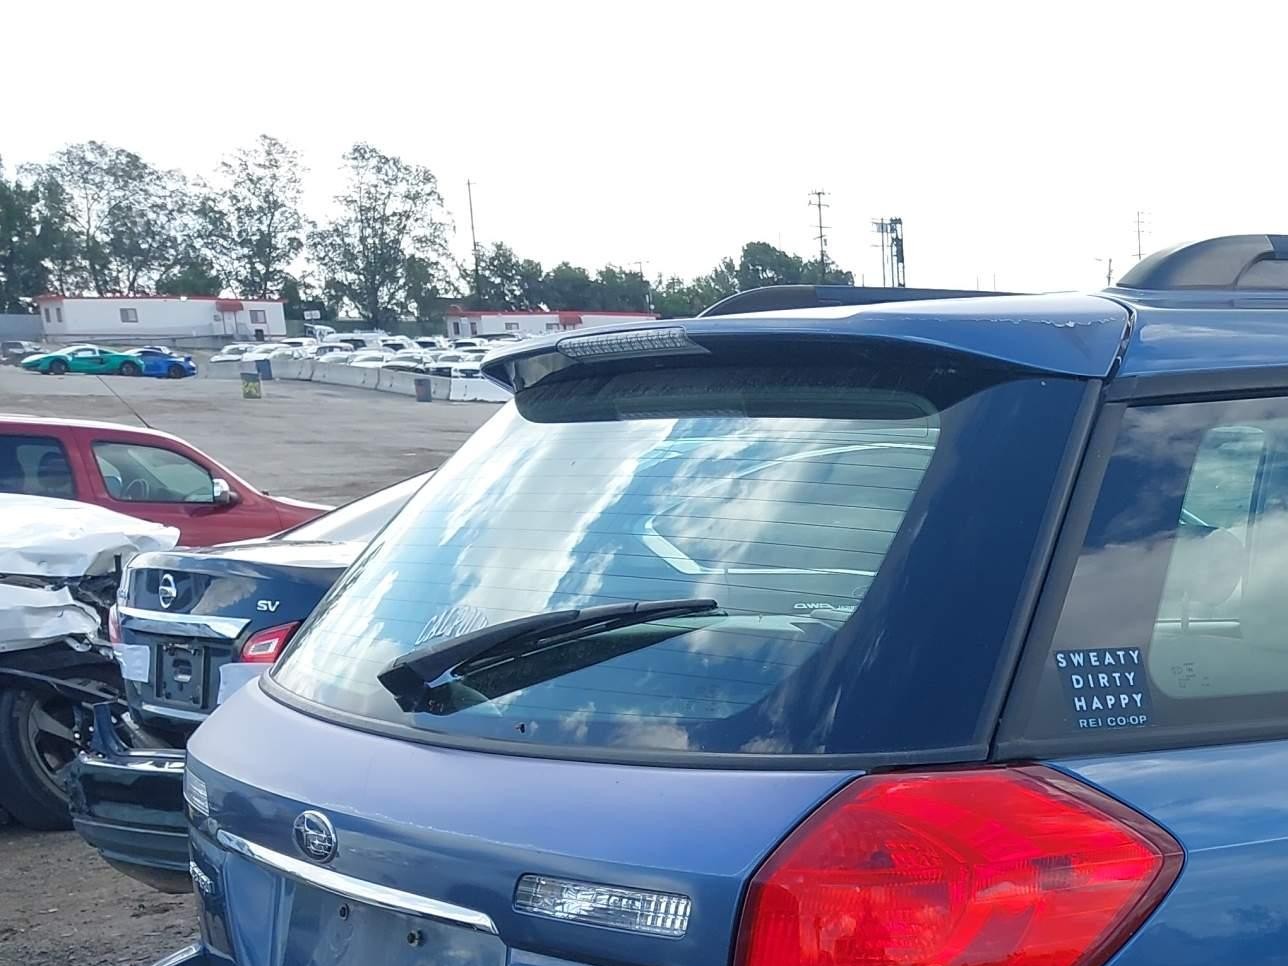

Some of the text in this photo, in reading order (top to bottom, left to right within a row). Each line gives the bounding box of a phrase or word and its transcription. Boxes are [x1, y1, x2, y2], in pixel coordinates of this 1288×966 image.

[256, 599, 280, 612] SV
[1056, 650, 1139, 667] SWEATY
[1071, 672, 1135, 689] DIRTY
[1074, 693, 1142, 711] HAPPY
[1079, 719, 1102, 728] REI
